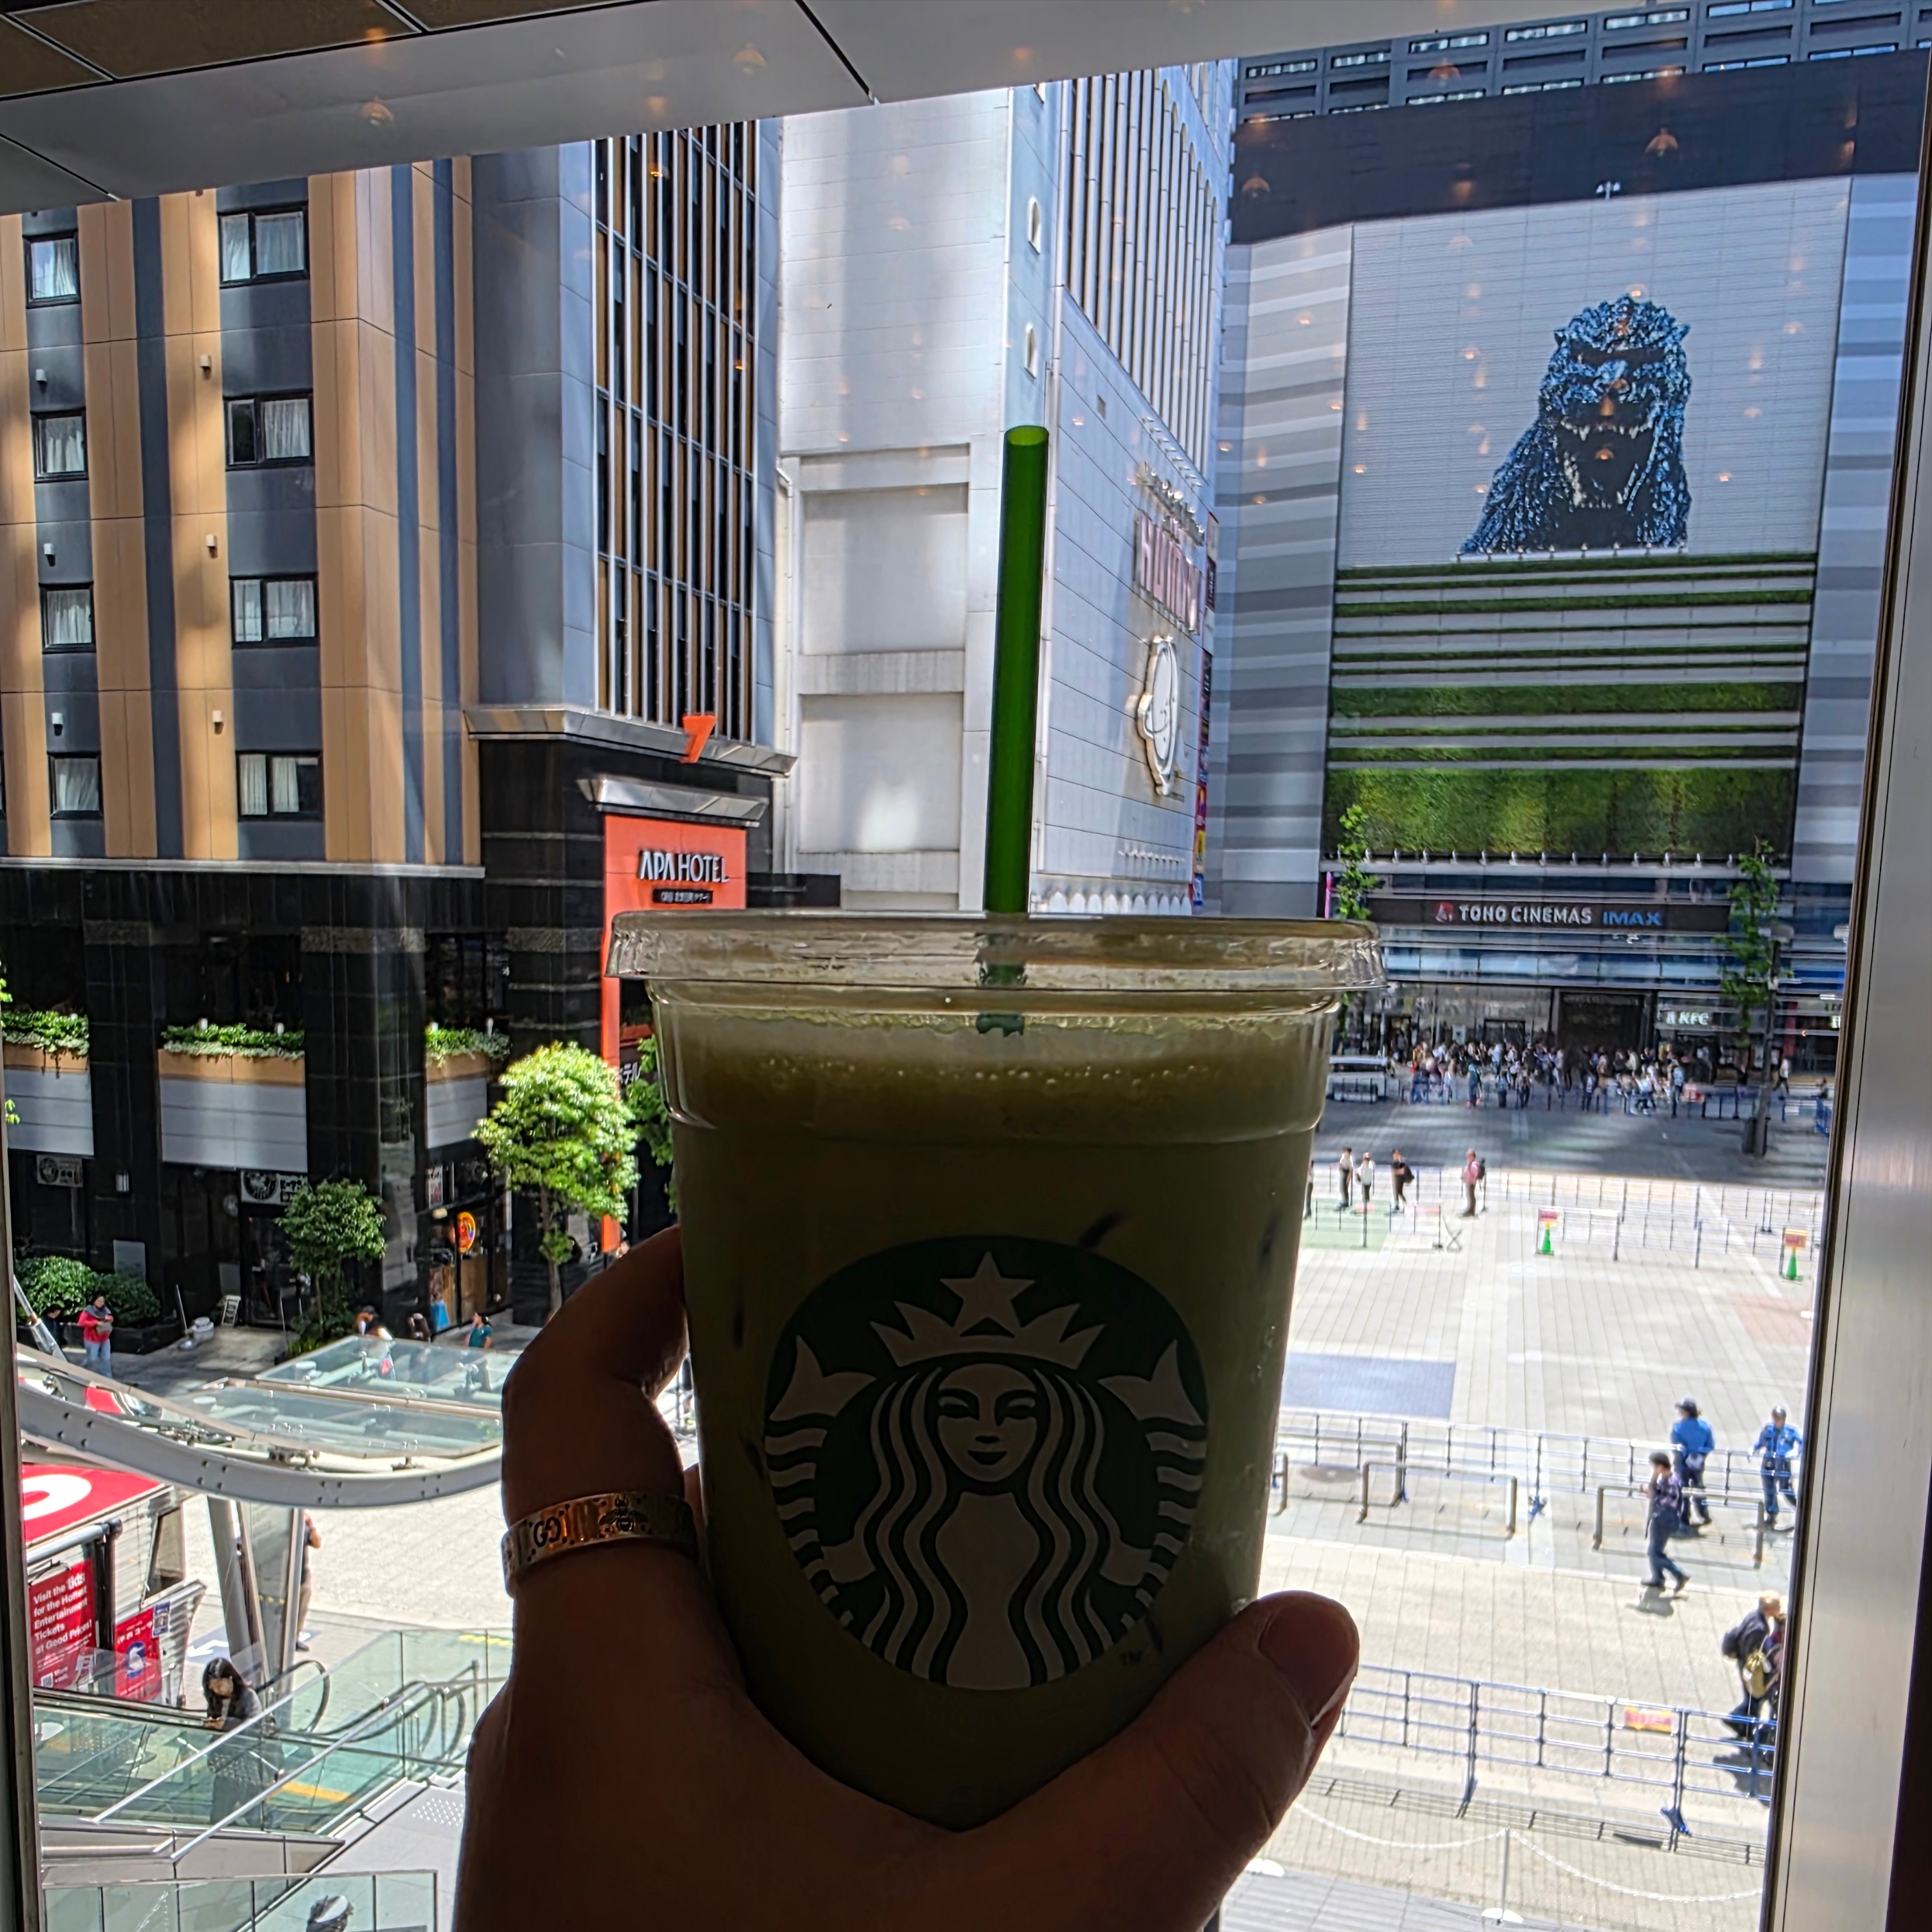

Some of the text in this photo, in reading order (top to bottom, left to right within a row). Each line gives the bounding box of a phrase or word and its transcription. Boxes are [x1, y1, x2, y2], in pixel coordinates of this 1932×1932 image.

[639, 851, 730, 883] APA HOTEL
[1459, 904, 1663, 926] TOHO CINEMAS IMAX
[1678, 1011, 1709, 1025] KFC
[33, 1589, 52, 1604] Visit
[53, 1584, 66, 1596] the
[33, 1604, 46, 1618] for
[46, 1599, 61, 1611] the
[34, 1597, 88, 1629] Entertainment
[35, 1622, 66, 1642] Tickets
[35, 1645, 45, 1654] at
[45, 1633, 68, 1650] Good
